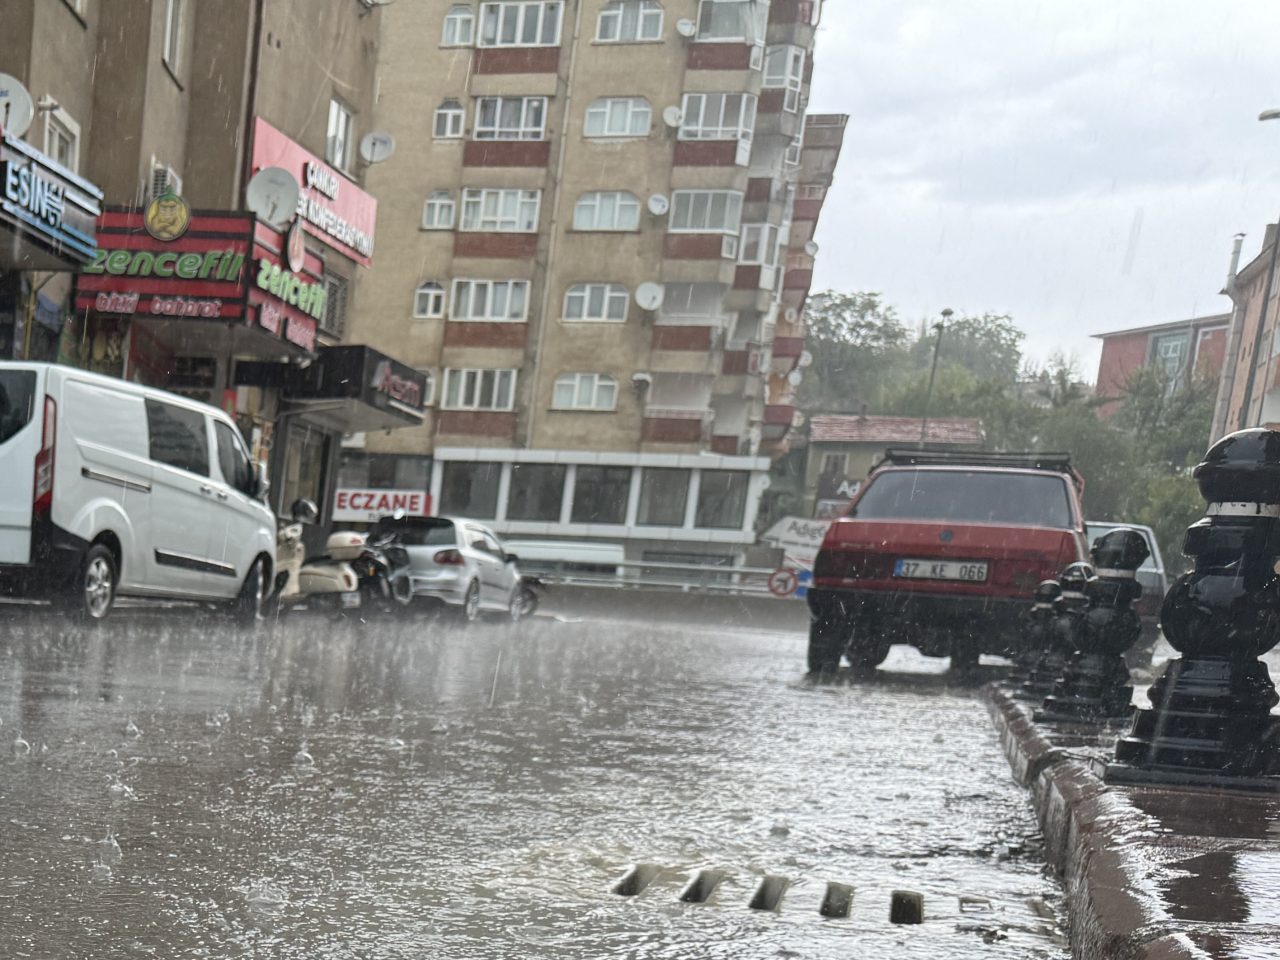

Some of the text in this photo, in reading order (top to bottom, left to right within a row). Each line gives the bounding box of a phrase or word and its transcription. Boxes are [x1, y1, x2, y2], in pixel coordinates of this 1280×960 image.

[82, 249, 245, 281] zencefil
[336, 492, 421, 512] ECZANE
[902, 563, 985, 580] 37 KE 066
